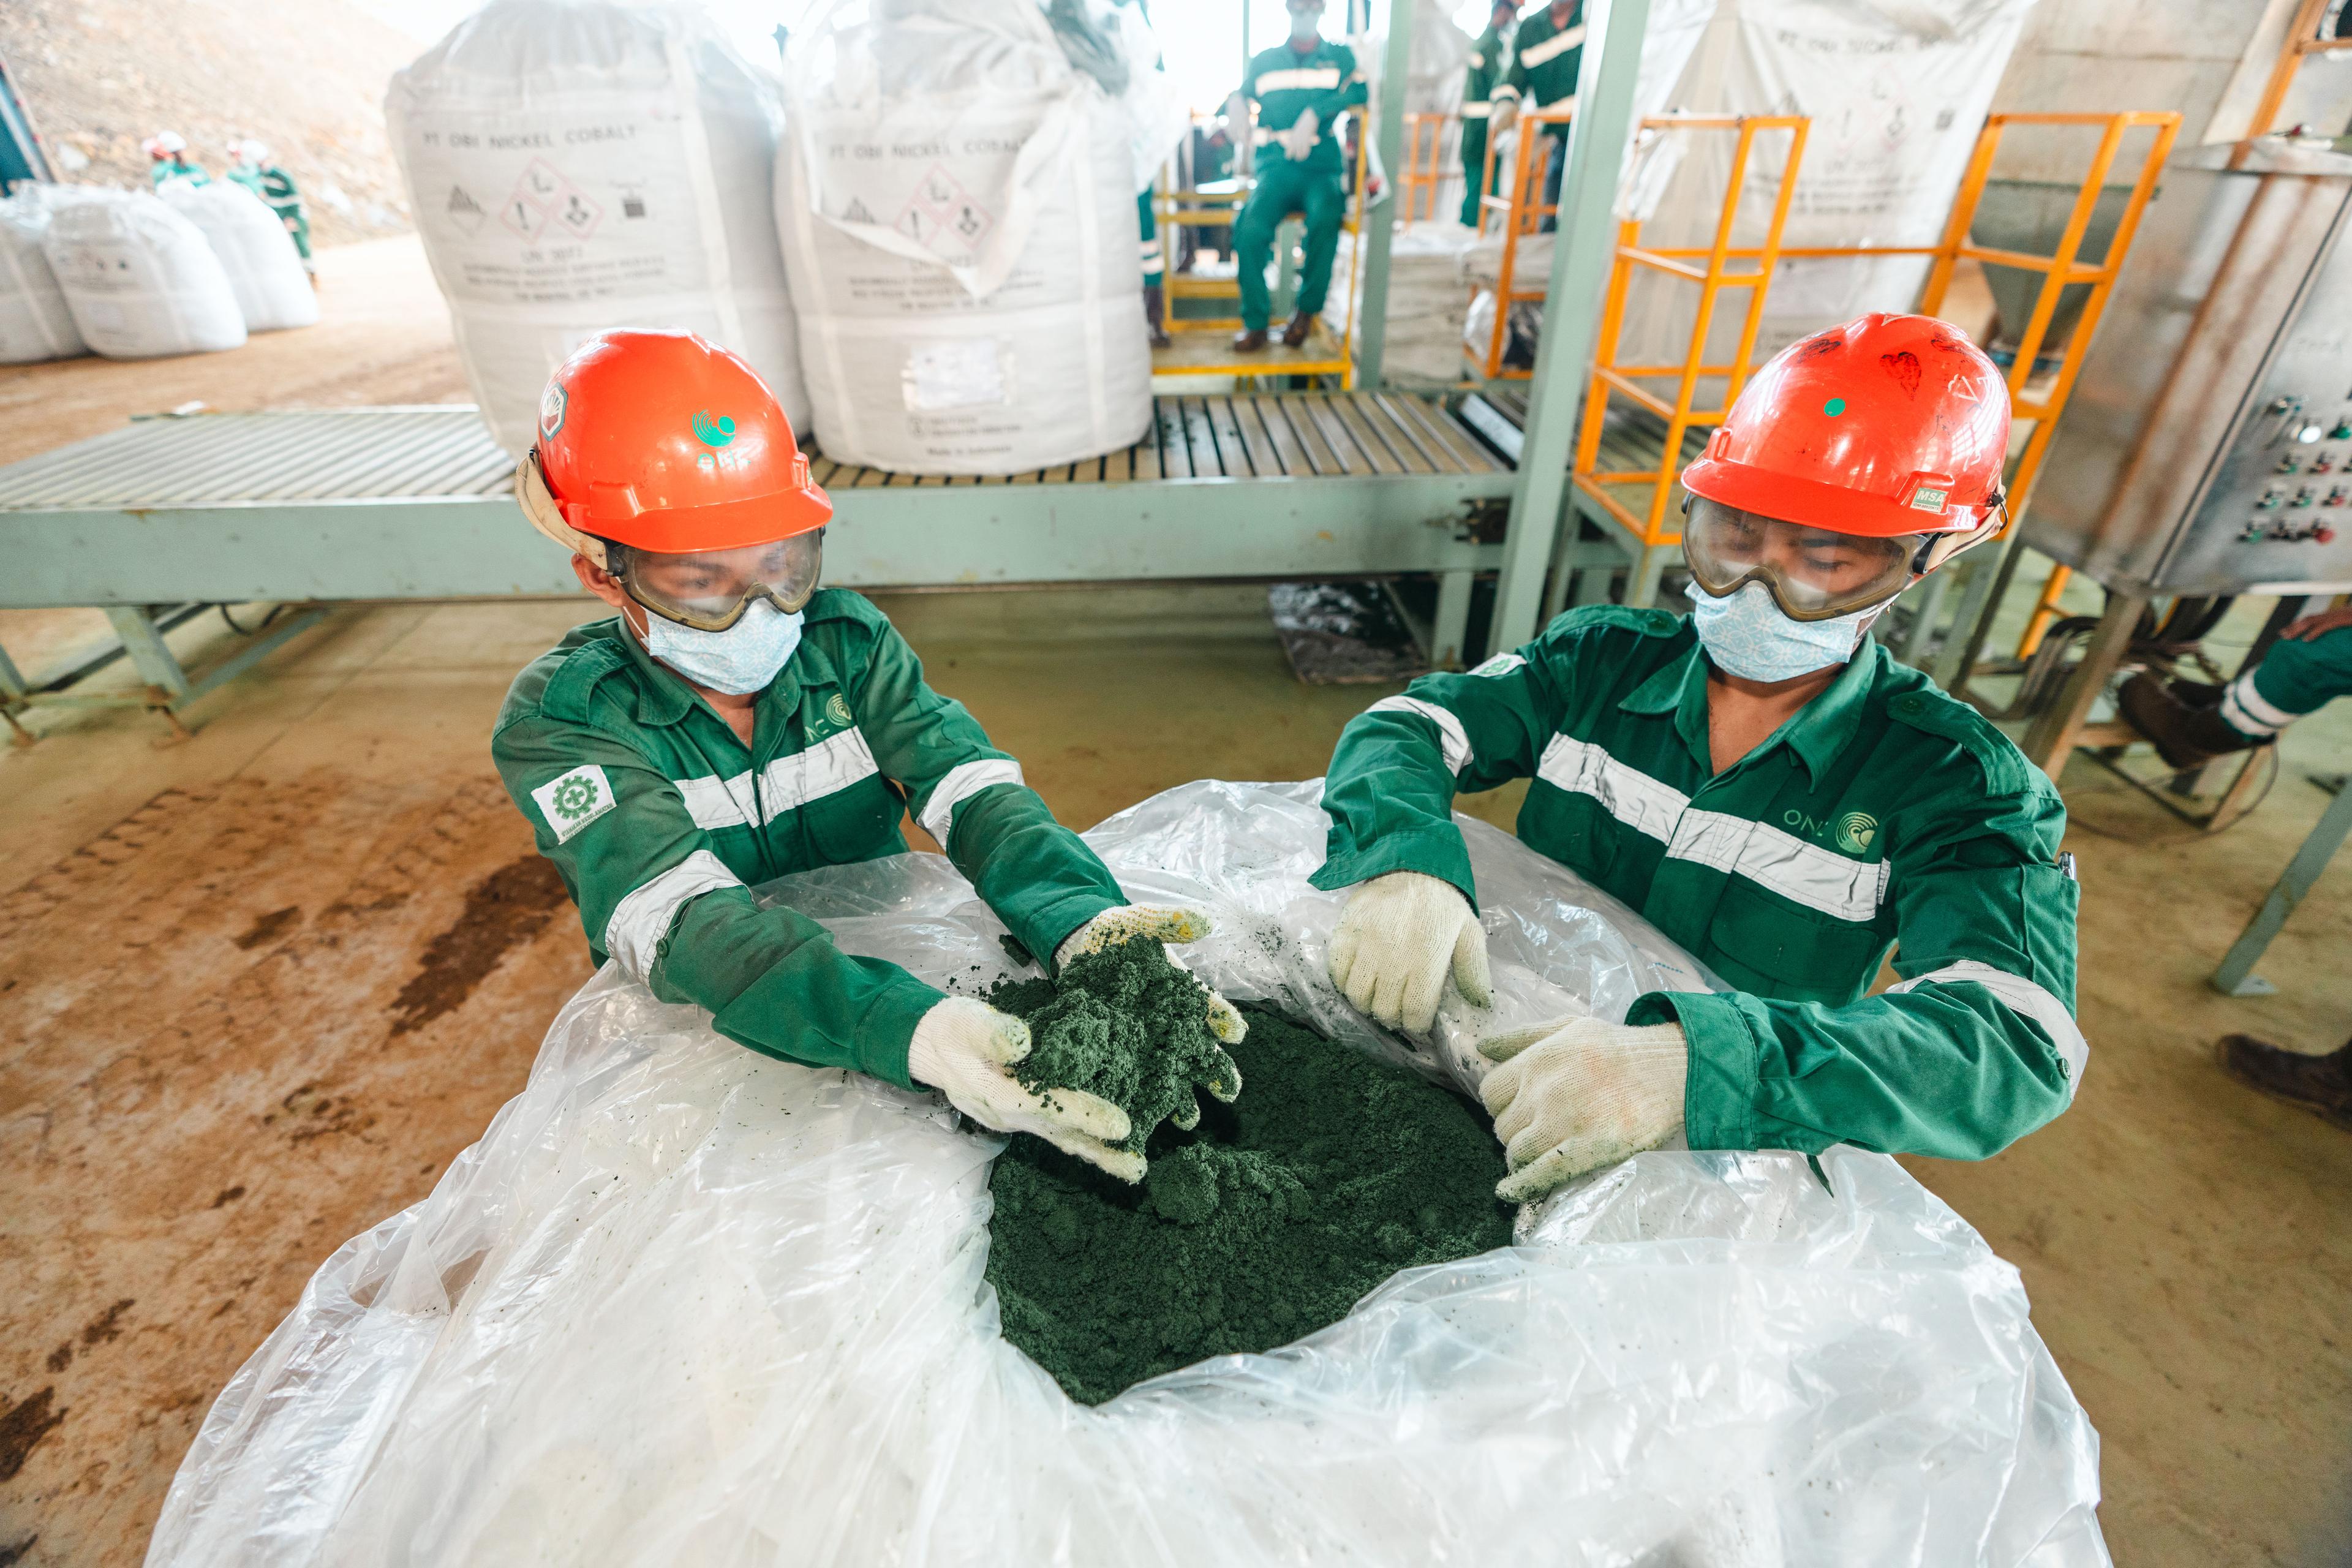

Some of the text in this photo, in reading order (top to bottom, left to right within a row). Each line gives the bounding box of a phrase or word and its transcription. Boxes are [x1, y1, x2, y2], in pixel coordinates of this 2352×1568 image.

[489, 130, 554, 150] NICKEL
[564, 124, 636, 146] COBALT
[697, 450, 751, 470] ON
[1917, 490, 1945, 502] MSA
[804, 718, 829, 742] NC
